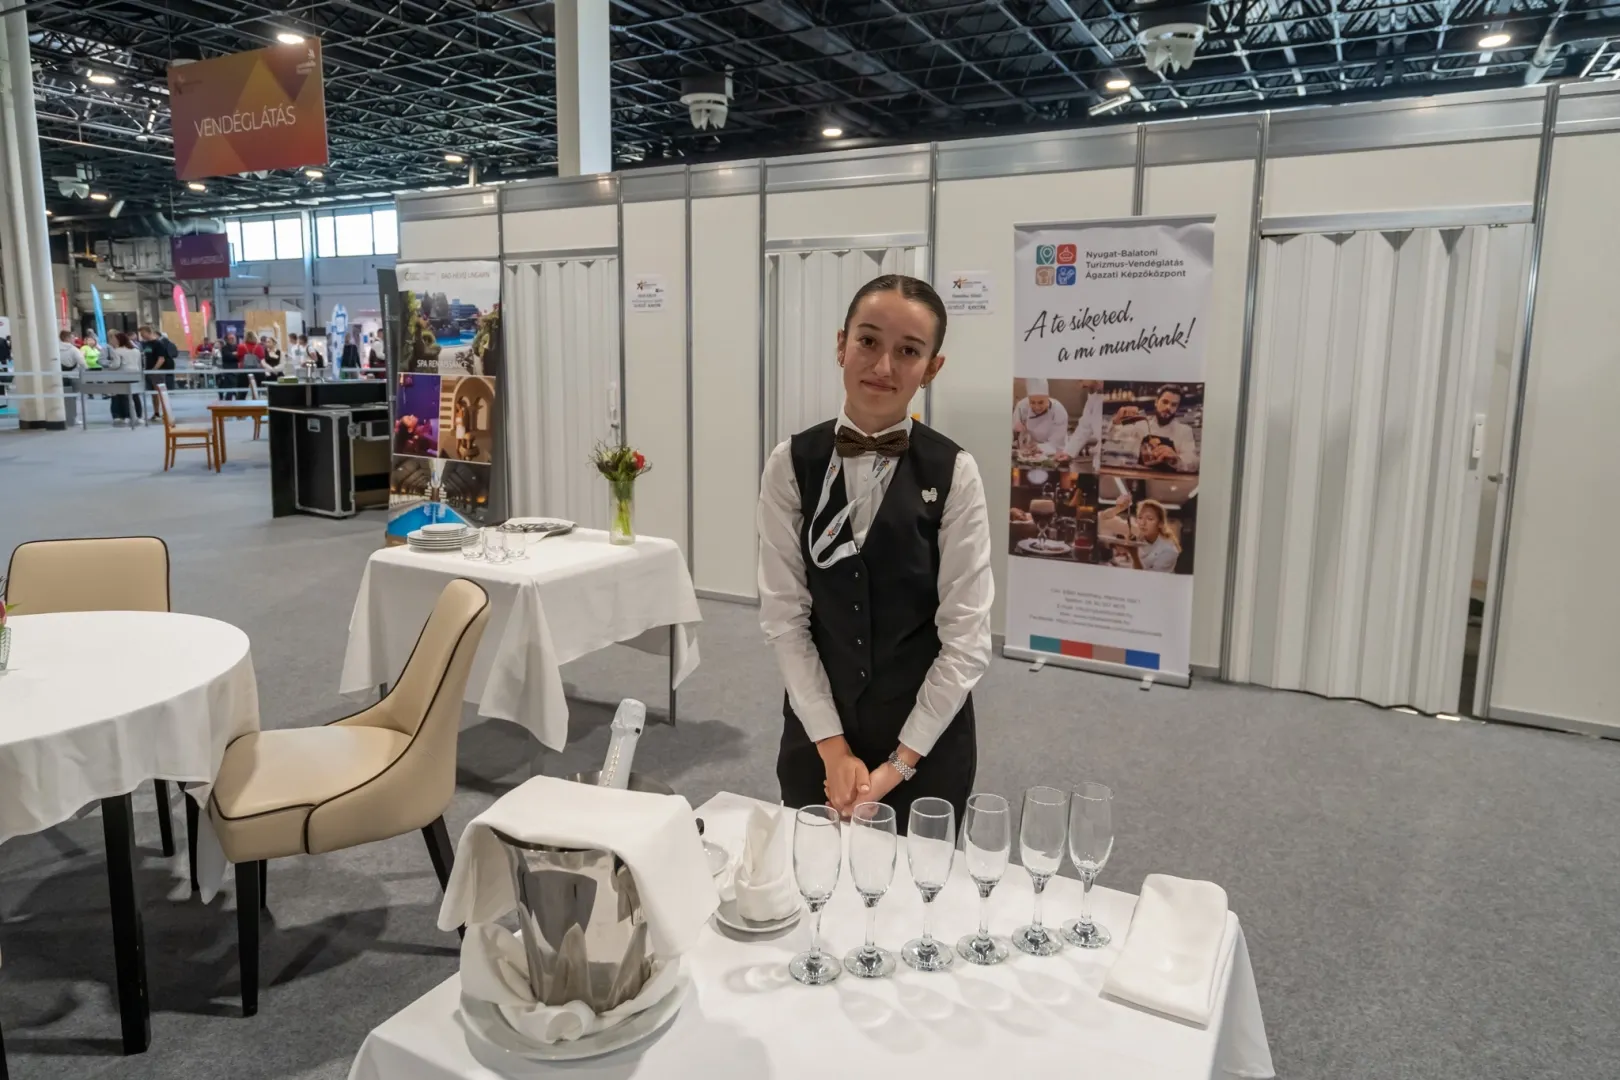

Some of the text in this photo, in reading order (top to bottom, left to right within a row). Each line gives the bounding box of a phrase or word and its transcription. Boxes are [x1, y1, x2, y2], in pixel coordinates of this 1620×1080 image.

[194, 104, 296, 138] VENDÉGLÁTÁS
[1086, 249, 1158, 259] Nyugat-Balatoni
[1086, 259, 1184, 268] Turizmus-Vendéglátás
[1085, 269, 1186, 280] Ágazati Képzőközpont
[1024, 310, 1047, 342] A
[1050, 314, 1066, 334] te
[1057, 317, 1197, 362] a mi munkánk!
[416, 359, 428, 368] SPA
